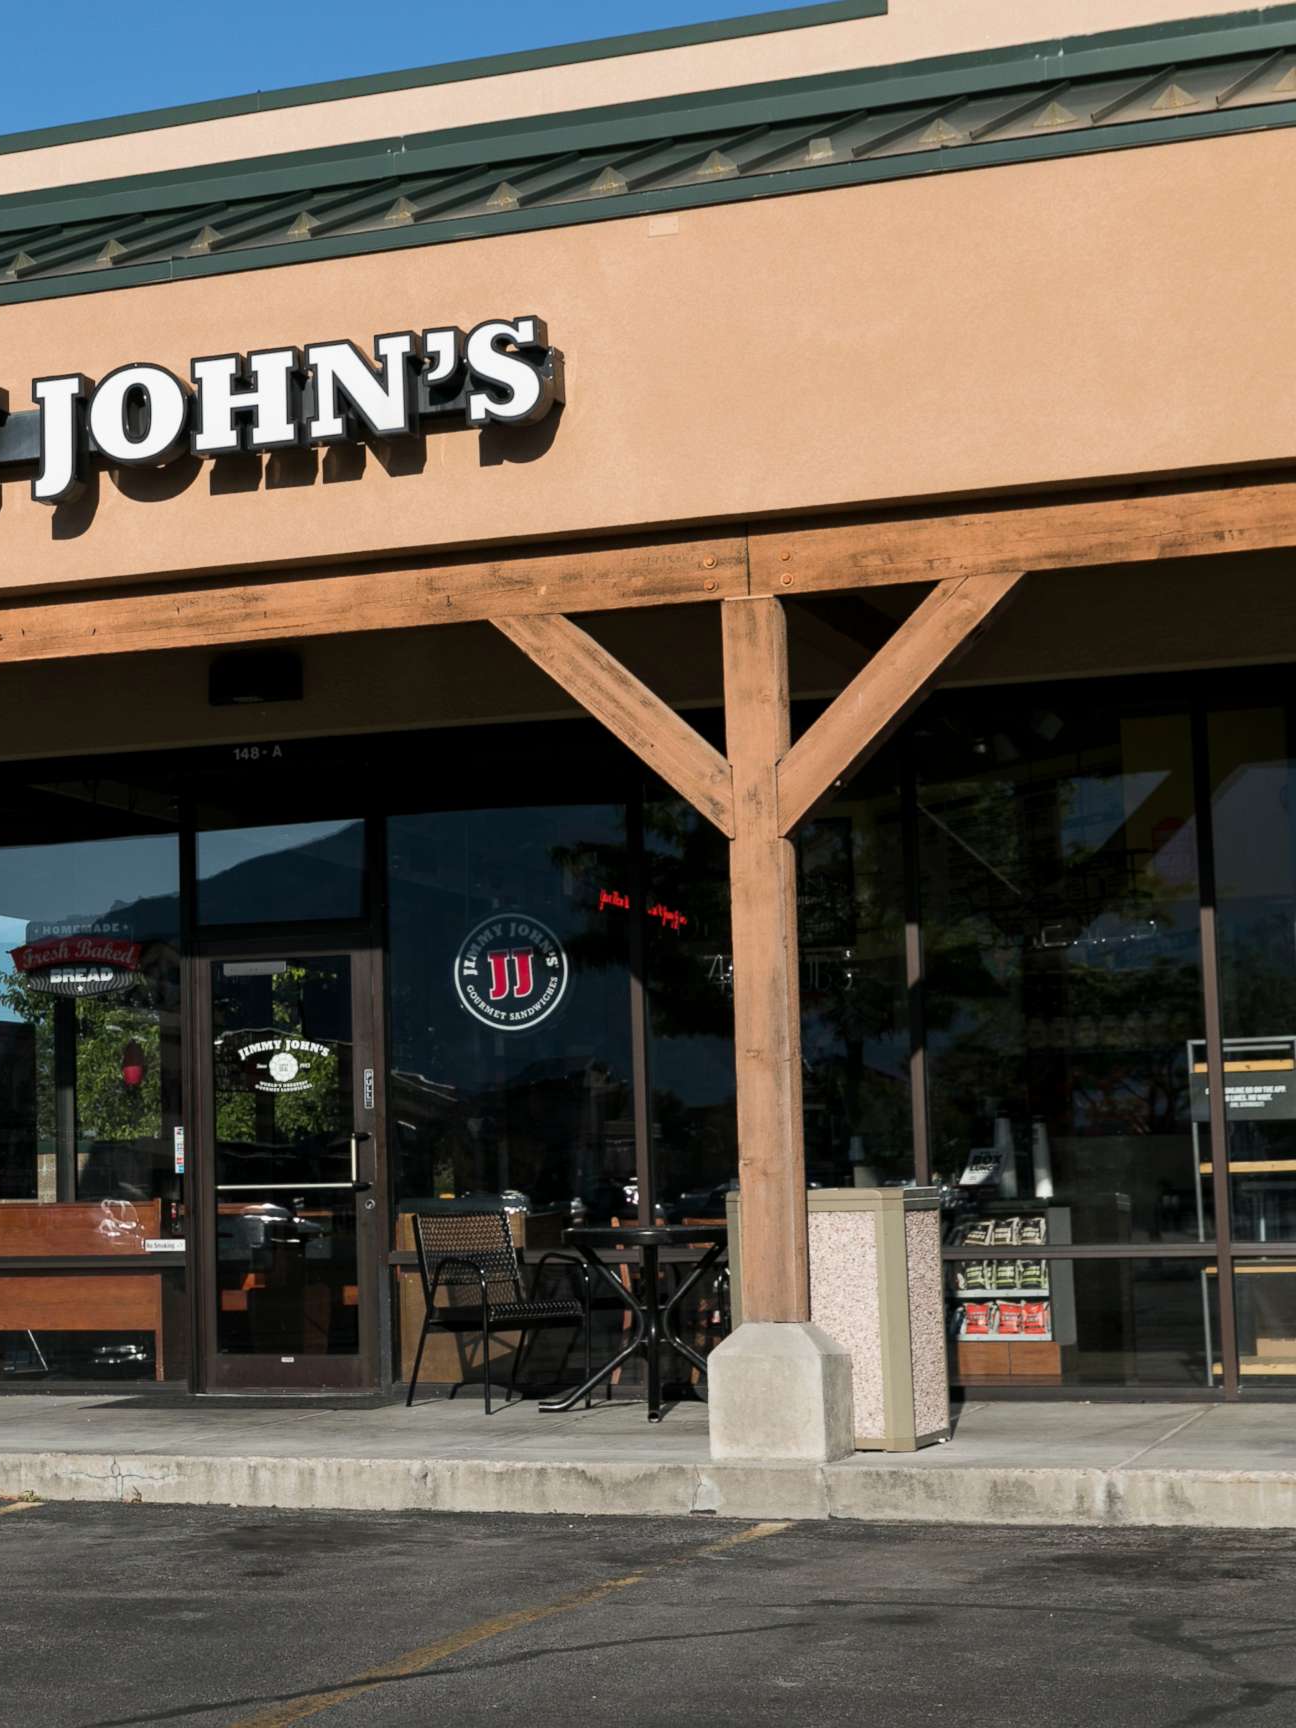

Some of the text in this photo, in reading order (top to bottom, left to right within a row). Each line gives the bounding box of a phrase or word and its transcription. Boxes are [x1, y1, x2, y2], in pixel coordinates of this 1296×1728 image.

[33, 315, 544, 501] JOHN'S
[42, 923, 120, 935] HOMEMADE
[23, 939, 134, 968] Fresh Baked
[463, 922, 559, 976] JIMMY JOHN'S
[50, 967, 114, 983] BREAD
[488, 947, 534, 1000] JJ
[466, 976, 558, 1020] GOURMET SANDWICHES
[238, 1039, 330, 1060] JIMMY JOHN'S
